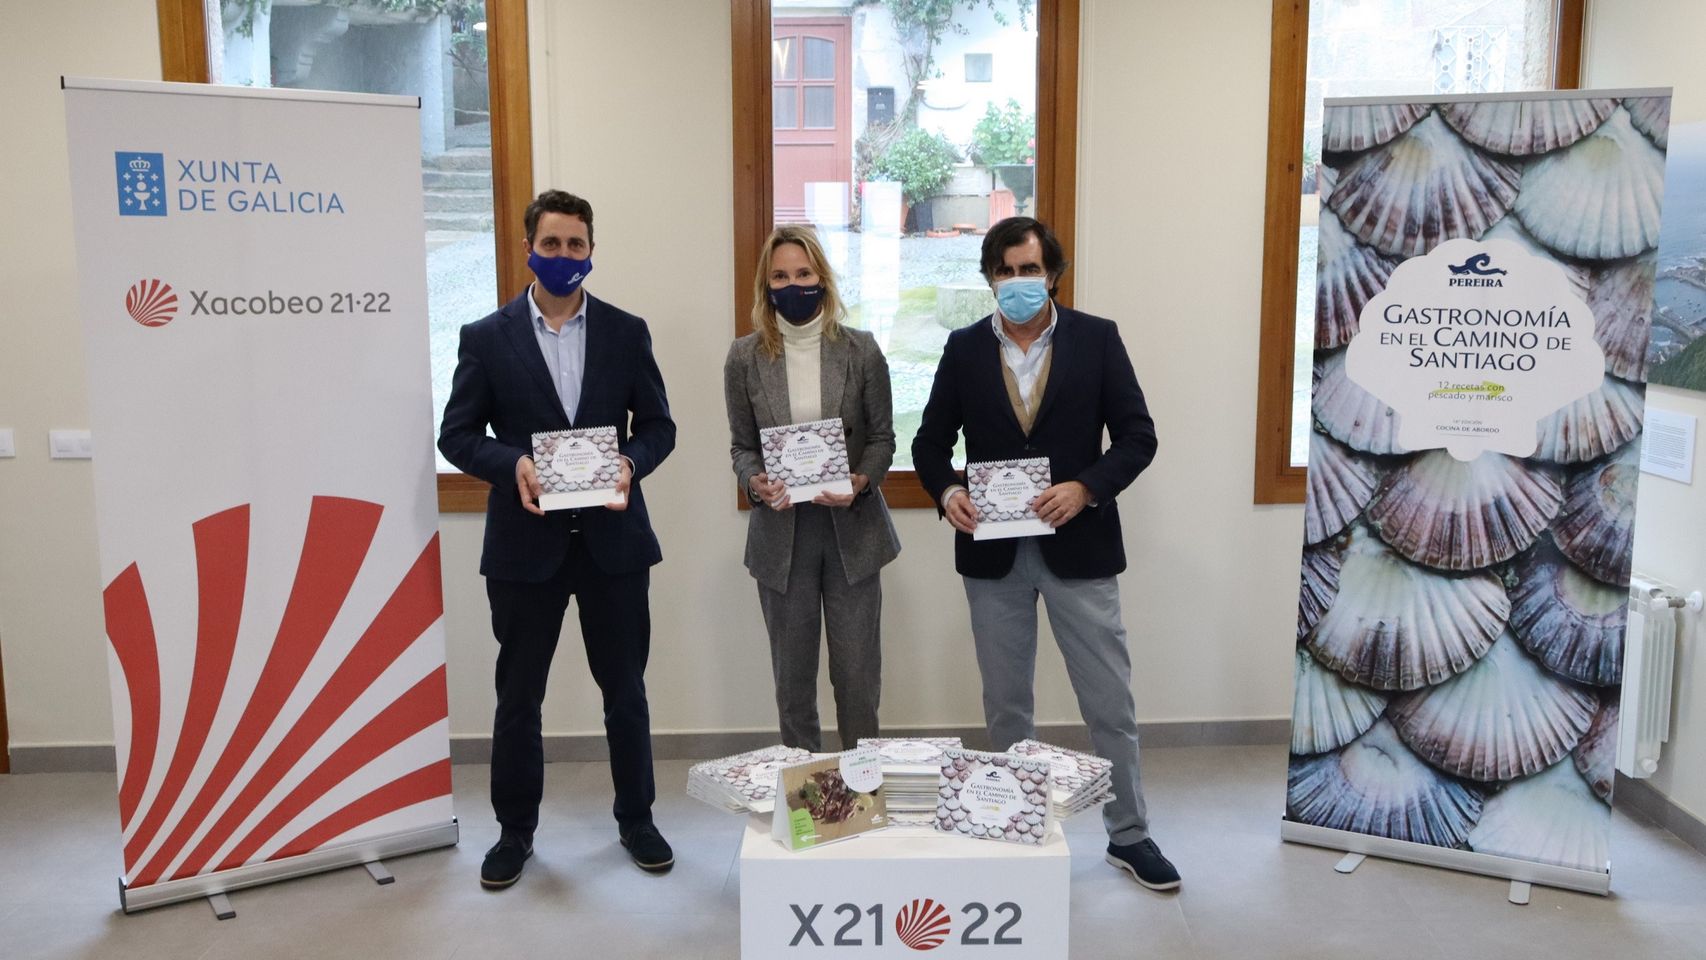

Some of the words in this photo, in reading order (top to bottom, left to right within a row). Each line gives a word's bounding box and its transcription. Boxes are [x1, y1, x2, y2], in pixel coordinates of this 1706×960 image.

[177, 159, 281, 184] XUNTA
[178, 189, 216, 212] DE
[228, 190, 345, 214] GALICIA
[1448, 278, 1504, 288] PEREIRA
[189, 290, 324, 316] Xacobeo
[1383, 304, 1571, 329] GASTRONOMÍA
[1380, 332, 1403, 346] EN
[1409, 333, 1428, 346] EL
[1433, 327, 1539, 350] CAMINO
[1546, 337, 1571, 350] DE
[1409, 348, 1536, 372] SANTIAGO
[1428, 392, 1466, 401] pescado
[1468, 394, 1474, 402] y
[1476, 394, 1513, 402] marisco
[1439, 381, 1450, 390] 12
[1452, 383, 1485, 391] recetas
[1487, 384, 1505, 392] con
[788, 904, 824, 947] X
[834, 903, 884, 946] 21
[960, 901, 1023, 946] 22
